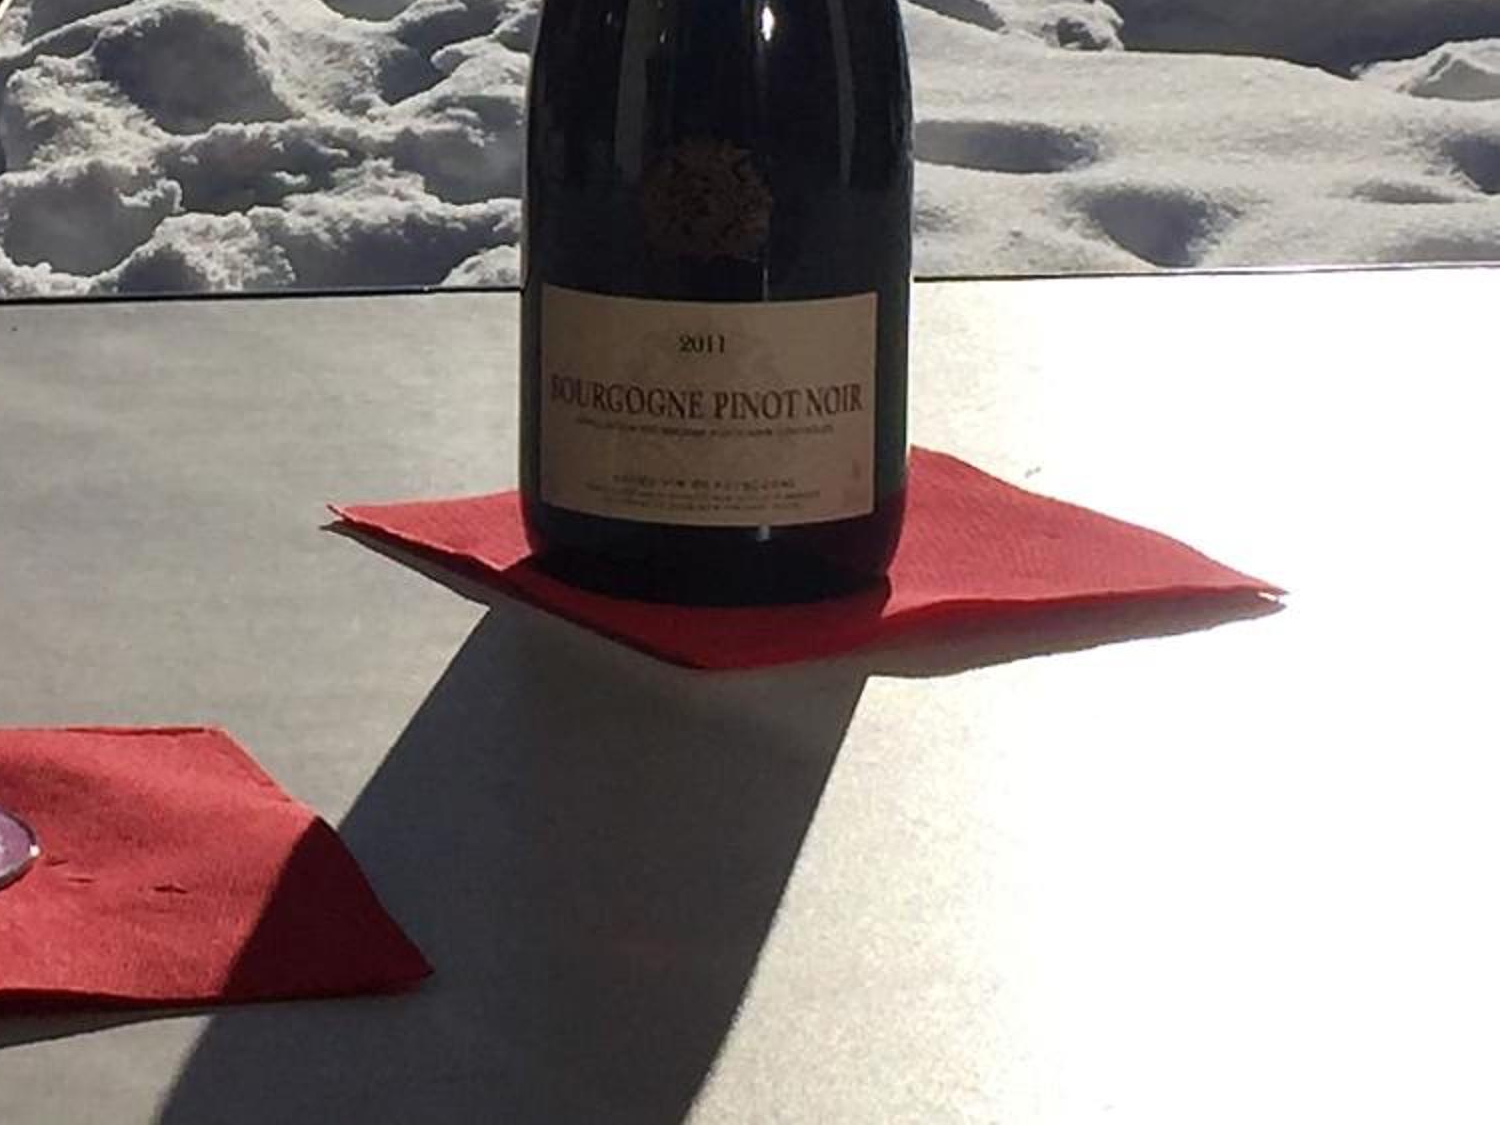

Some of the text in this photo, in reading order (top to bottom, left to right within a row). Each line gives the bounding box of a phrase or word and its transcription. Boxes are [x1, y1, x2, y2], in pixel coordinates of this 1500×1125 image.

[679, 335, 726, 354] 2011
[551, 374, 863, 420] BOURGOGNE PINOT NOIR
